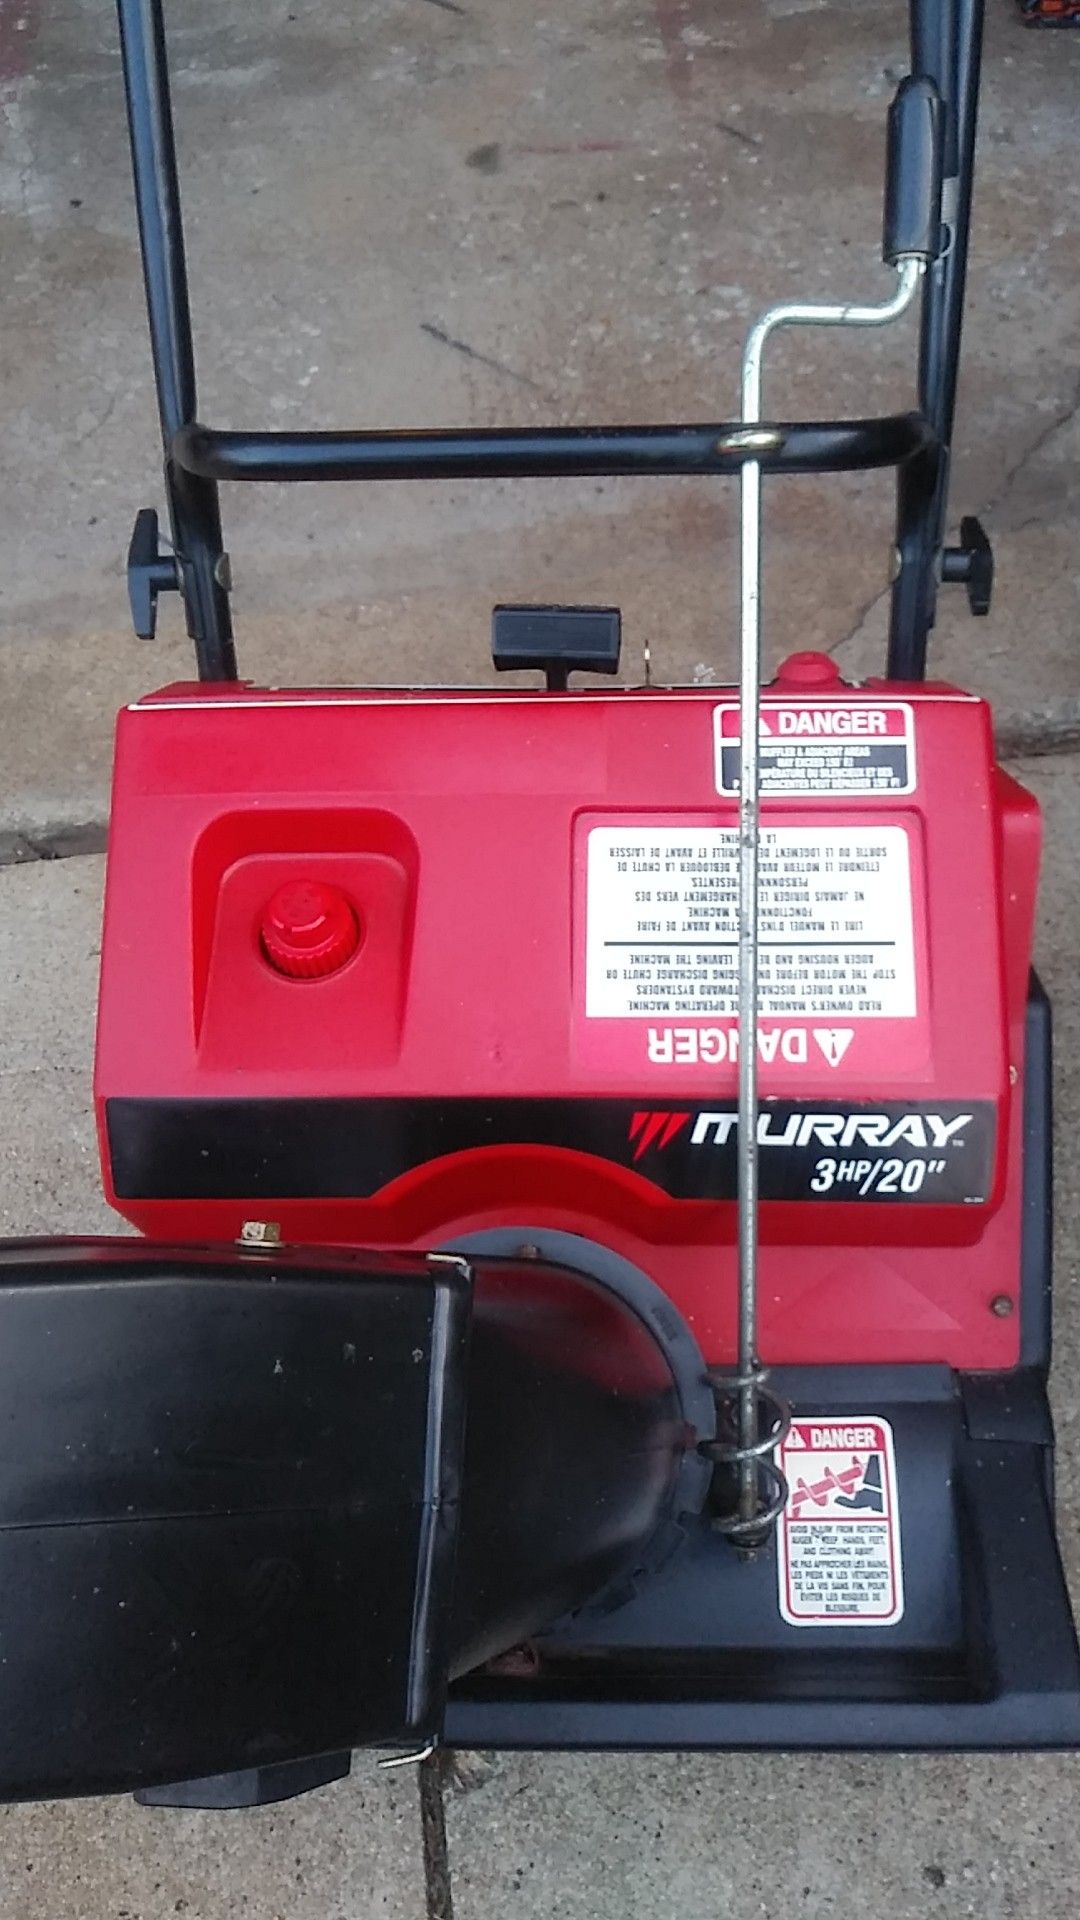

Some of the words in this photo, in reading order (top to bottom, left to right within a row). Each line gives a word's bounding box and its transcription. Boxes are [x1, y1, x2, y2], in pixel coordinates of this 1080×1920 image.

[778, 711, 887, 734] DANGER
[766, 832, 776, 844] LA
[608, 847, 645, 857] LAISSER
[649, 847, 660, 857] DE
[664, 847, 693, 857] AVANT
[698, 847, 707, 857] ET
[774, 847, 820, 857] LOGEMENT
[824, 847, 834, 857] LE
[855, 847, 887, 857] SORTIE
[616, 861, 627, 872] DE
[632, 861, 660, 872] CHUTE
[664, 861, 675, 872] LA
[680, 861, 730, 872] DEBLOQUER
[783, 861, 820, 872] MOTEUR
[824, 861, 833, 872] LE
[838, 861, 880, 872] ETEINDRE
[634, 891, 651, 902] DES
[656, 891, 678, 902] VERS
[760, 891, 768, 902] LE
[774, 891, 810, 902] DIRIGER
[815, 891, 848, 902] JAMAIS
[854, 891, 864, 902] NE
[636, 921, 661, 932] FAIRE
[666, 921, 676, 932] DE
[682, 921, 710, 932] AVANT
[790, 921, 825, 932] MANUEL
[830, 921, 839, 932] LE
[844, 921, 863, 932] LIRE
[676, 954, 691, 964] THE
[696, 954, 732, 964] LEAVING
[775, 954, 792, 964] AND
[798, 954, 838, 964] HOUSING
[844, 954, 874, 964] AUGER
[606, 969, 618, 980] OR
[622, 969, 651, 980] CHUTE
[656, 969, 708, 980] DISCHARGE
[776, 969, 808, 980] BEFORE
[813, 969, 846, 980] MOTOR
[851, 969, 867, 980] THE
[872, 969, 896, 980] STOP
[636, 984, 694, 996] BYSTANDERS
[801, 984, 833, 996] DIRECT
[839, 984, 866, 996] NEVER
[675, 1000, 725, 1011] OPERATING
[769, 1000, 806, 1011] MANUAL
[811, 1000, 853, 1011] OWNER'S
[858, 1000, 882, 1011] READ
[690, 1113, 974, 1147] MURRAY
[810, 1427, 877, 1448] DANGER
